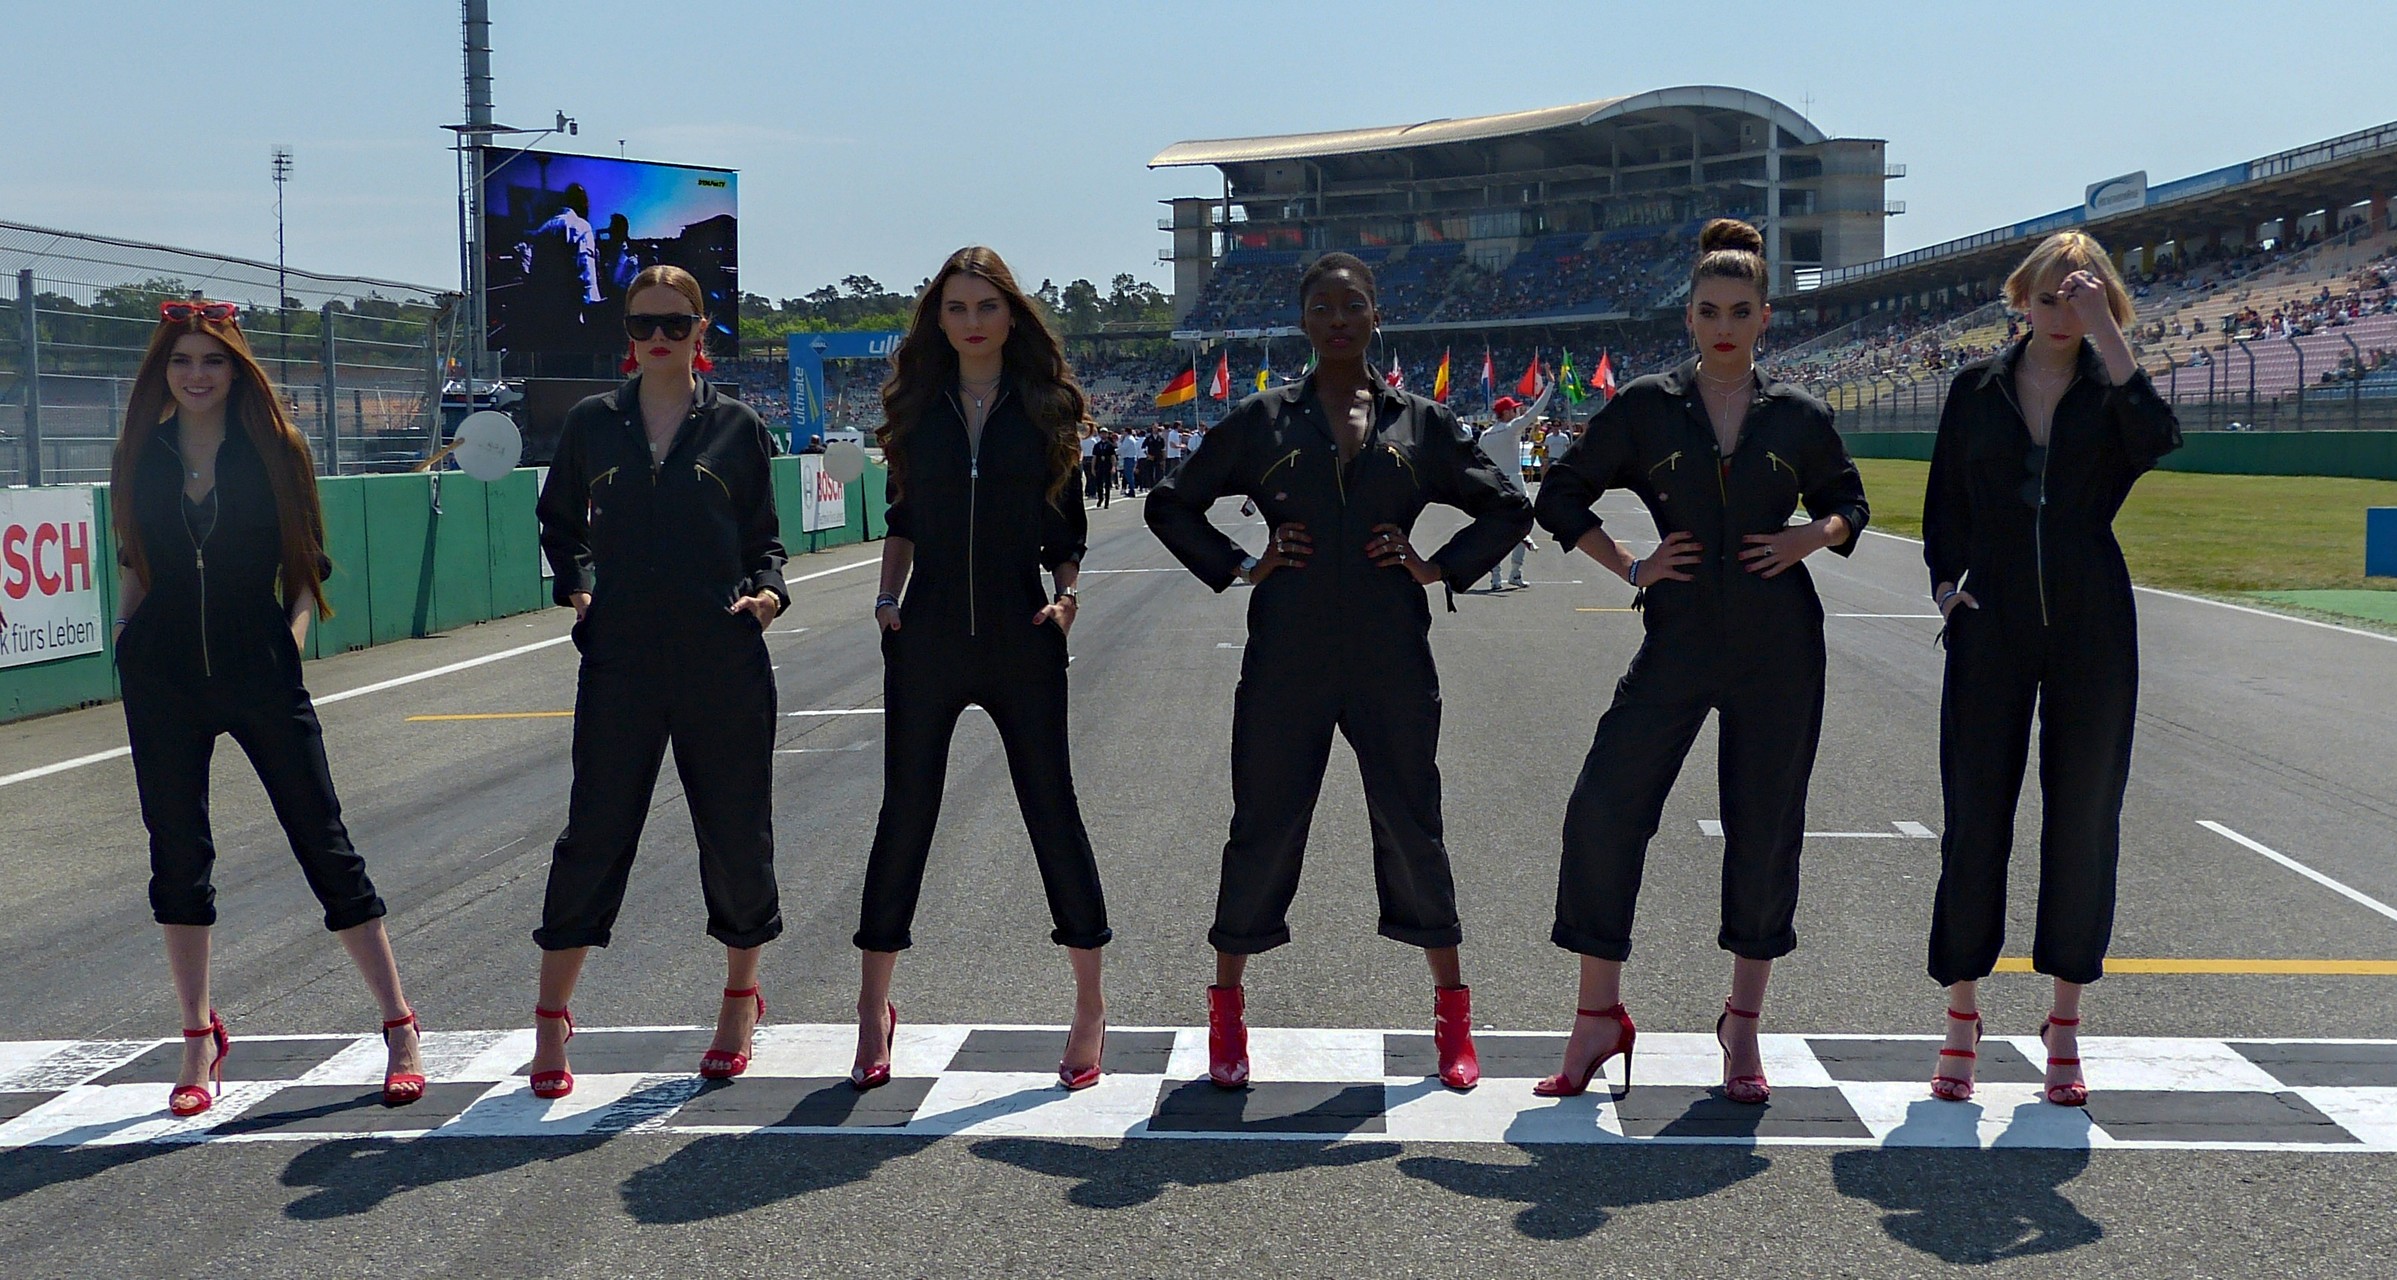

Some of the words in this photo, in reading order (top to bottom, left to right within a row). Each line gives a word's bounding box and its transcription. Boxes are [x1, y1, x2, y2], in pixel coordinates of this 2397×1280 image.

[792, 366, 805, 425] ultimate
[0, 522, 91, 600] SCH
[12, 622, 45, 654] fürs
[48, 616, 94, 648] Leben
